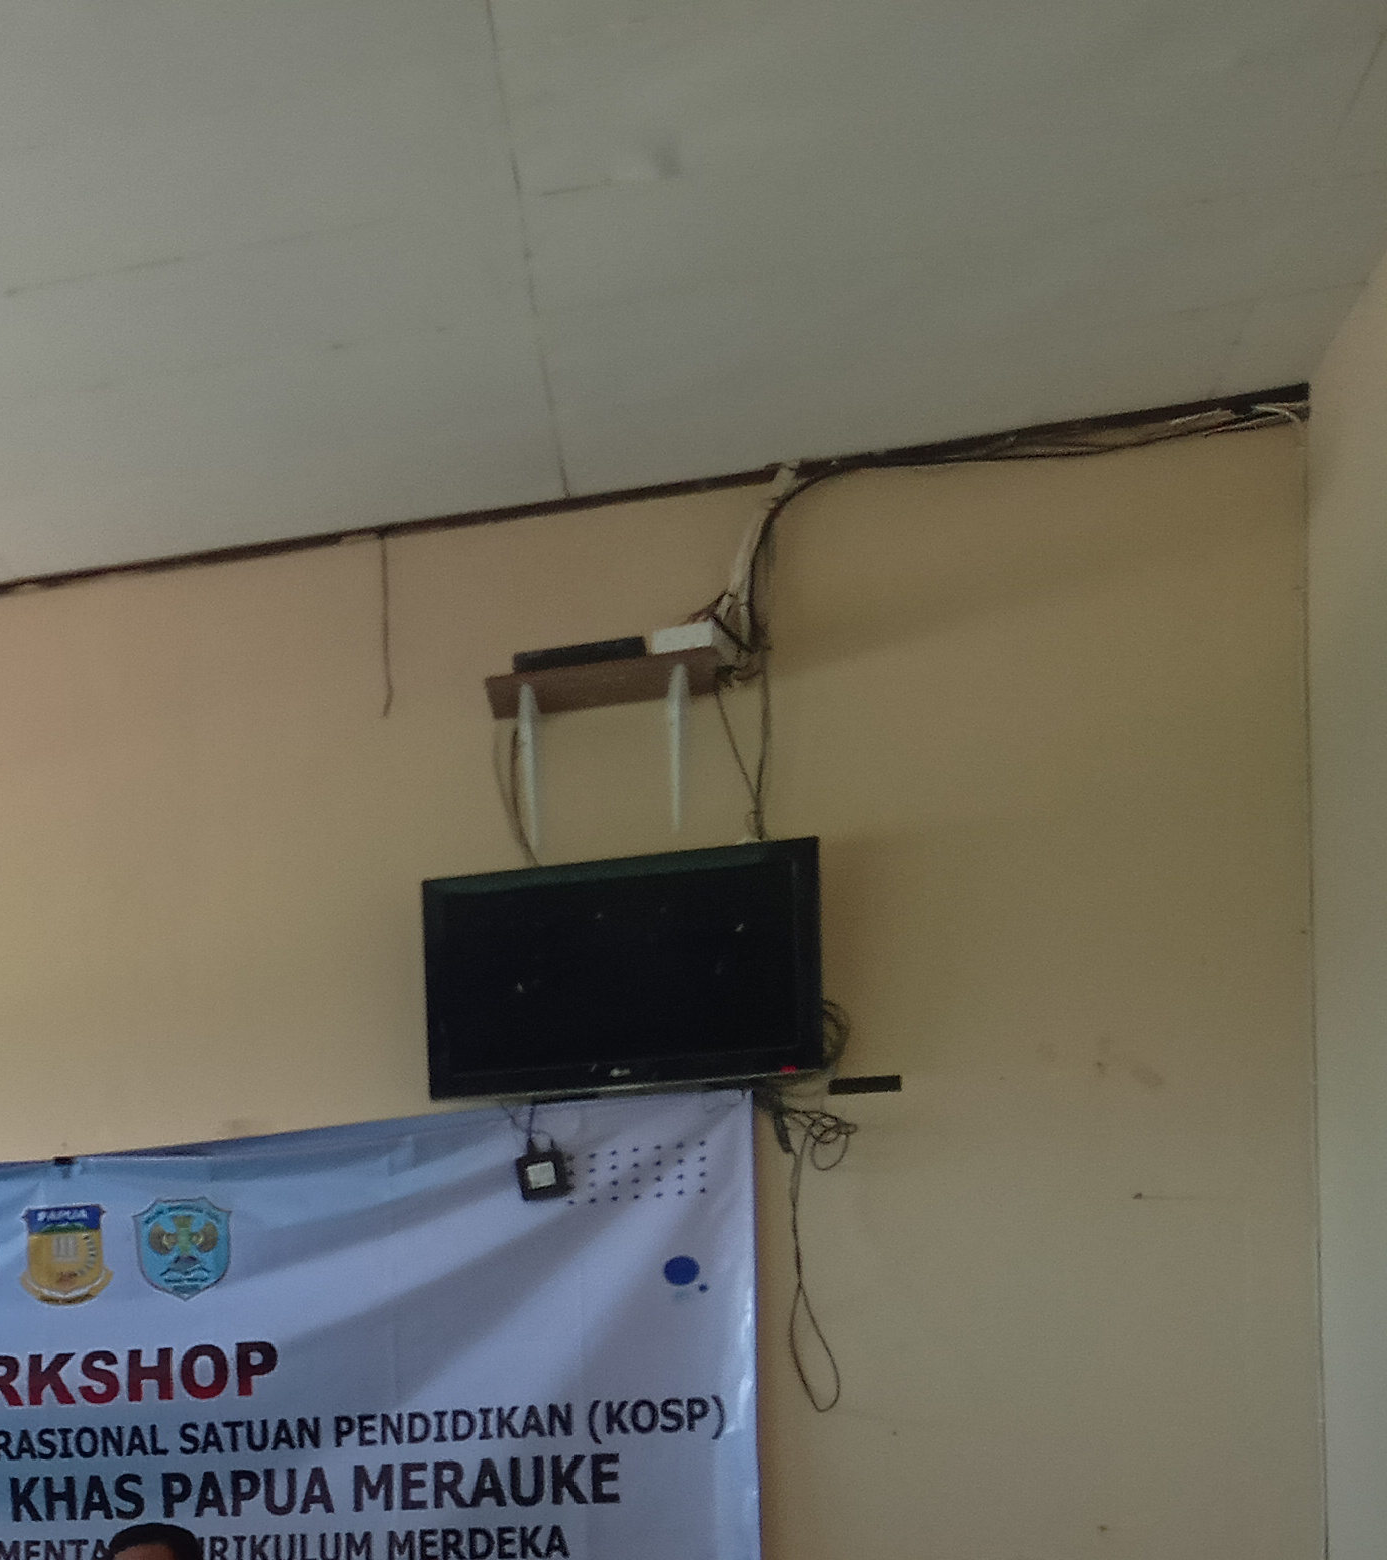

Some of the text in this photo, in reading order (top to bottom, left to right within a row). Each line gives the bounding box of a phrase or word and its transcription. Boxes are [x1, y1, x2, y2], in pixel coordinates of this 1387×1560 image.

[179, 1417, 322, 1457] SATUAN
[333, 1402, 574, 1448] PENDIDIKAN
[587, 1394, 726, 1444] (KOSP)
[10, 1472, 146, 1523] KHAS
[161, 1464, 335, 1520] PAPUA
[352, 1452, 622, 1513] MERAUKE
